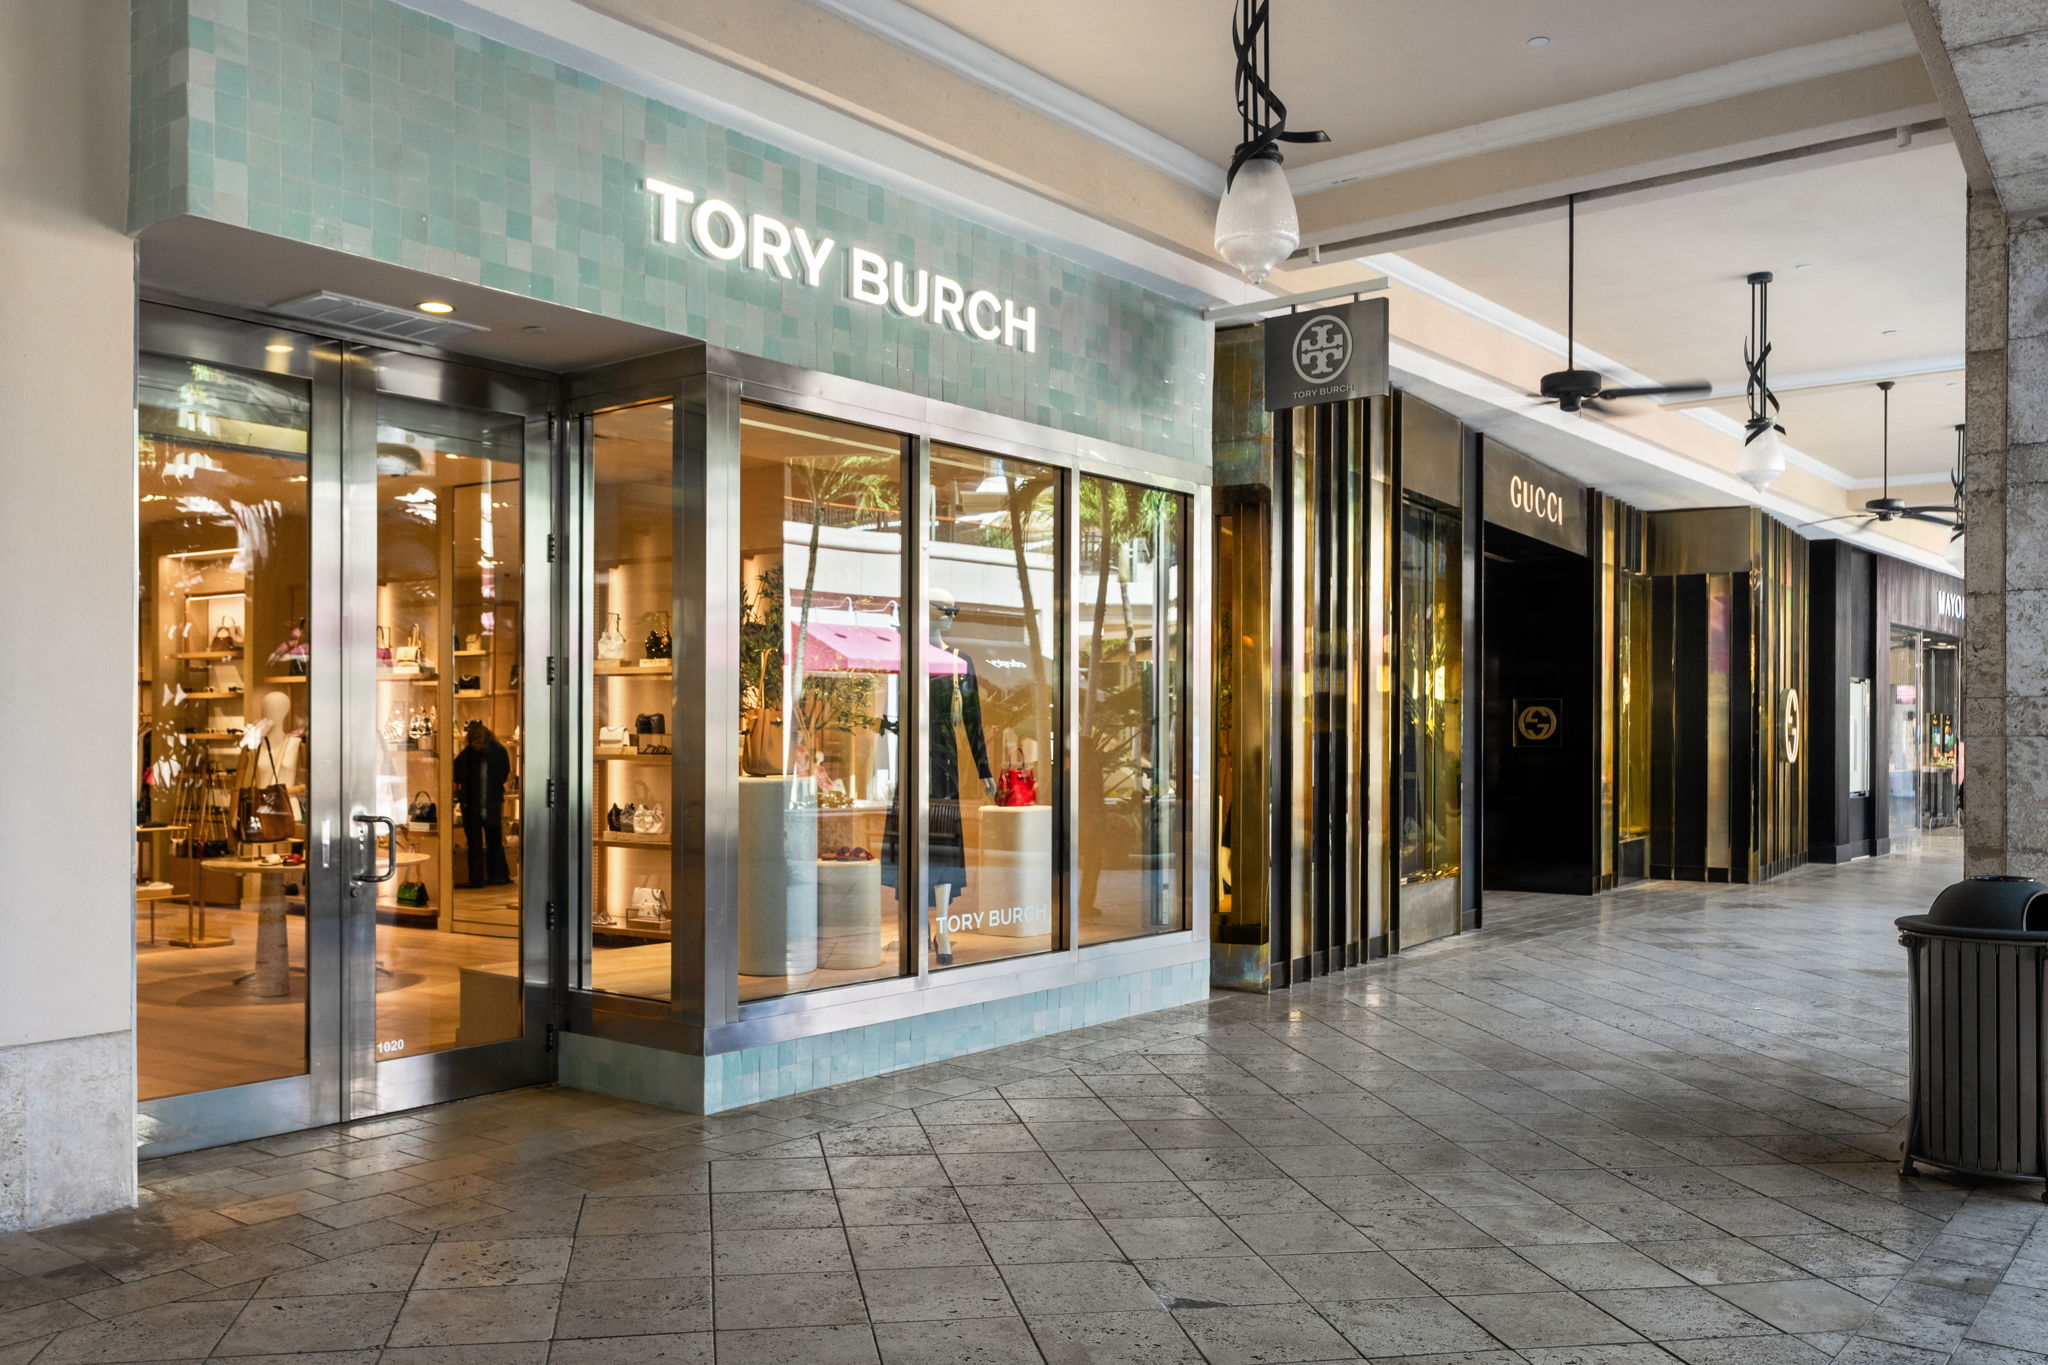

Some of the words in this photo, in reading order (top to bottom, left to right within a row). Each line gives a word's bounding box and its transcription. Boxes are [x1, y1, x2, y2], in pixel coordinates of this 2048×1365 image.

[644, 177, 836, 288] TORY
[849, 246, 1036, 354] BURCH
[1292, 388, 1318, 399] TORY
[1319, 383, 1354, 396] BURCH
[1510, 474, 1563, 526] GUCCI
[936, 911, 985, 935] TORY
[988, 904, 1048, 928] BURCH
[376, 1038, 405, 1054] 1020
